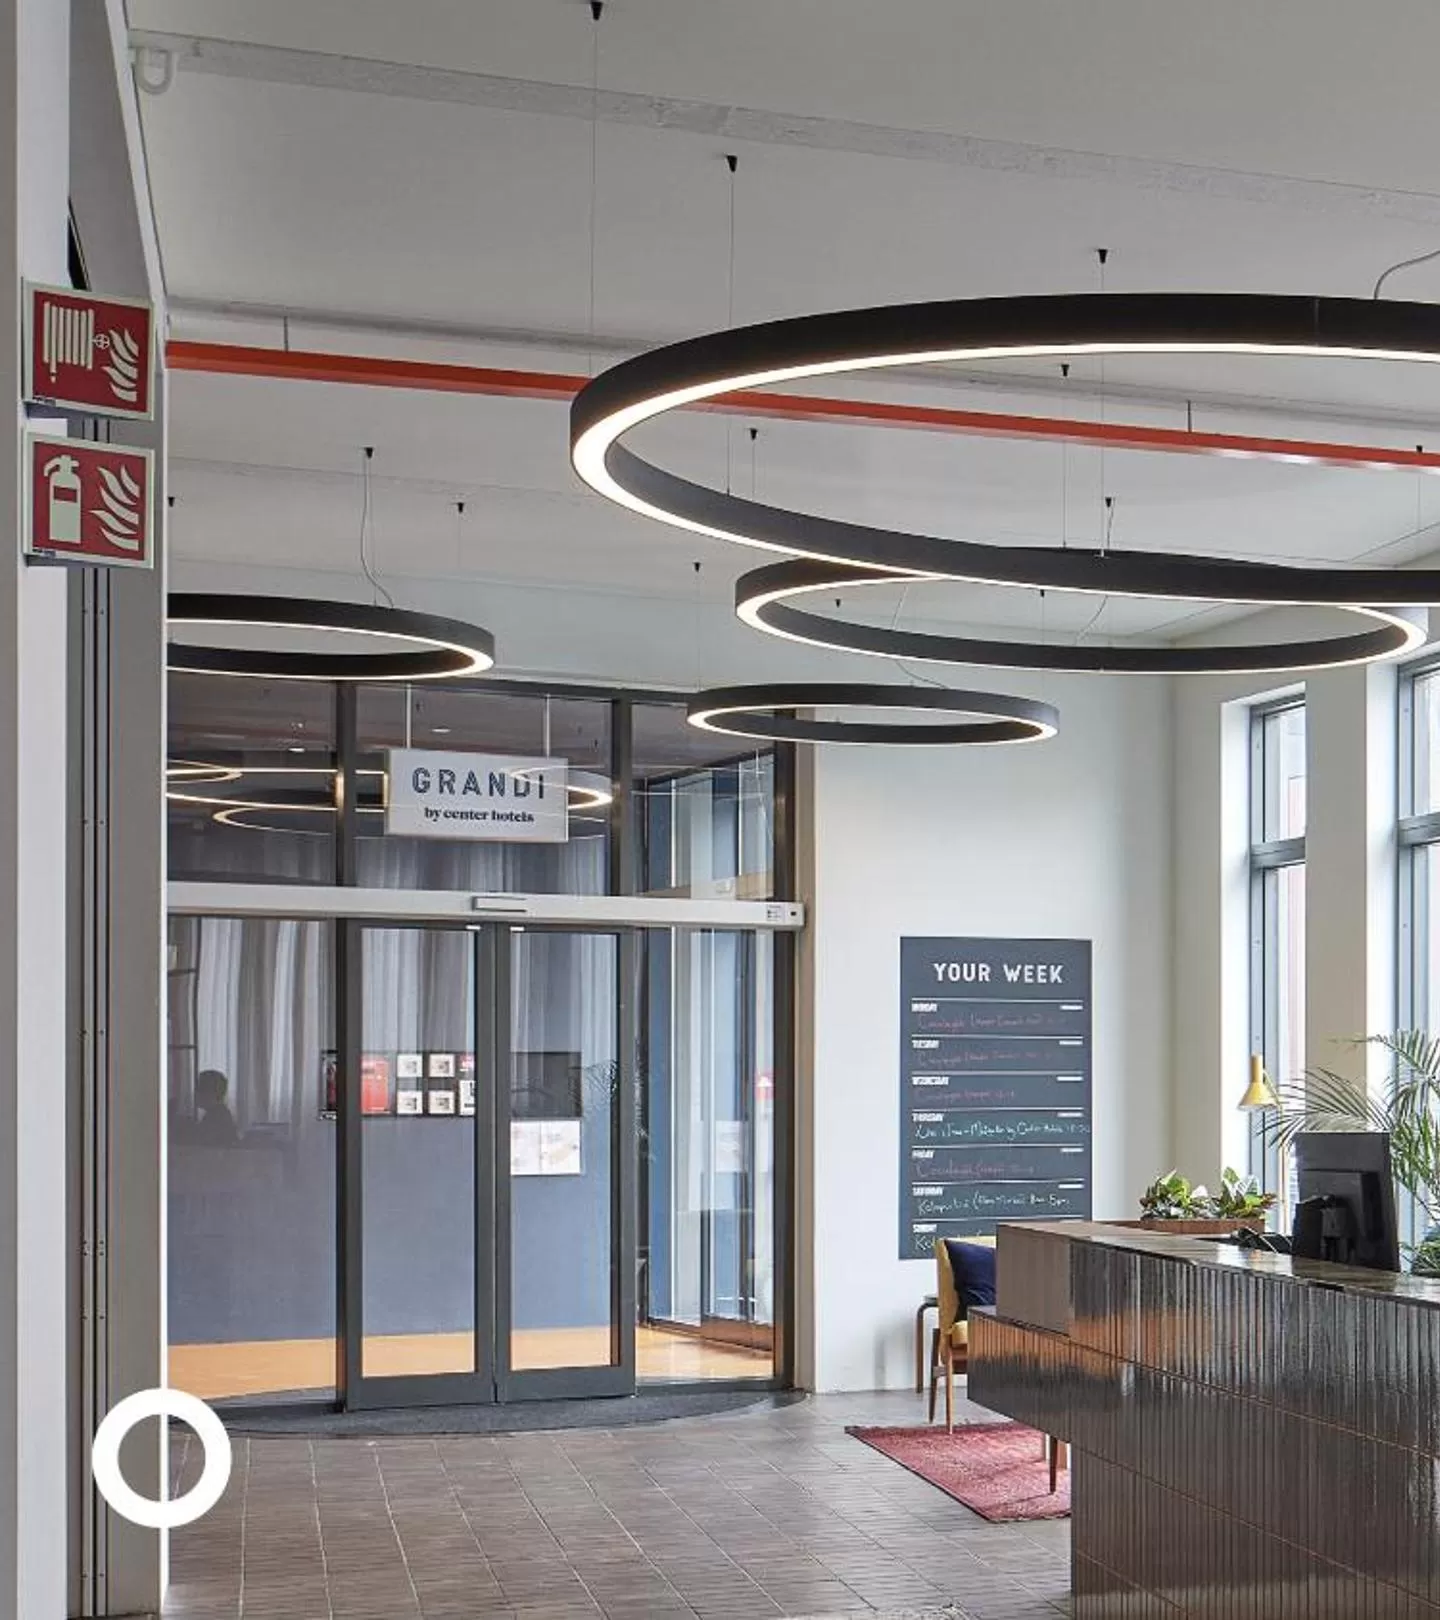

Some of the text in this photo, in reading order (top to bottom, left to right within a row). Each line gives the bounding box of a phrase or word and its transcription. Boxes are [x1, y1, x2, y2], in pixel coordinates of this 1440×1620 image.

[411, 767, 545, 799] GRANDI
[424, 807, 535, 822] by center hotels
[934, 963, 1064, 984] YOUR WEEK
